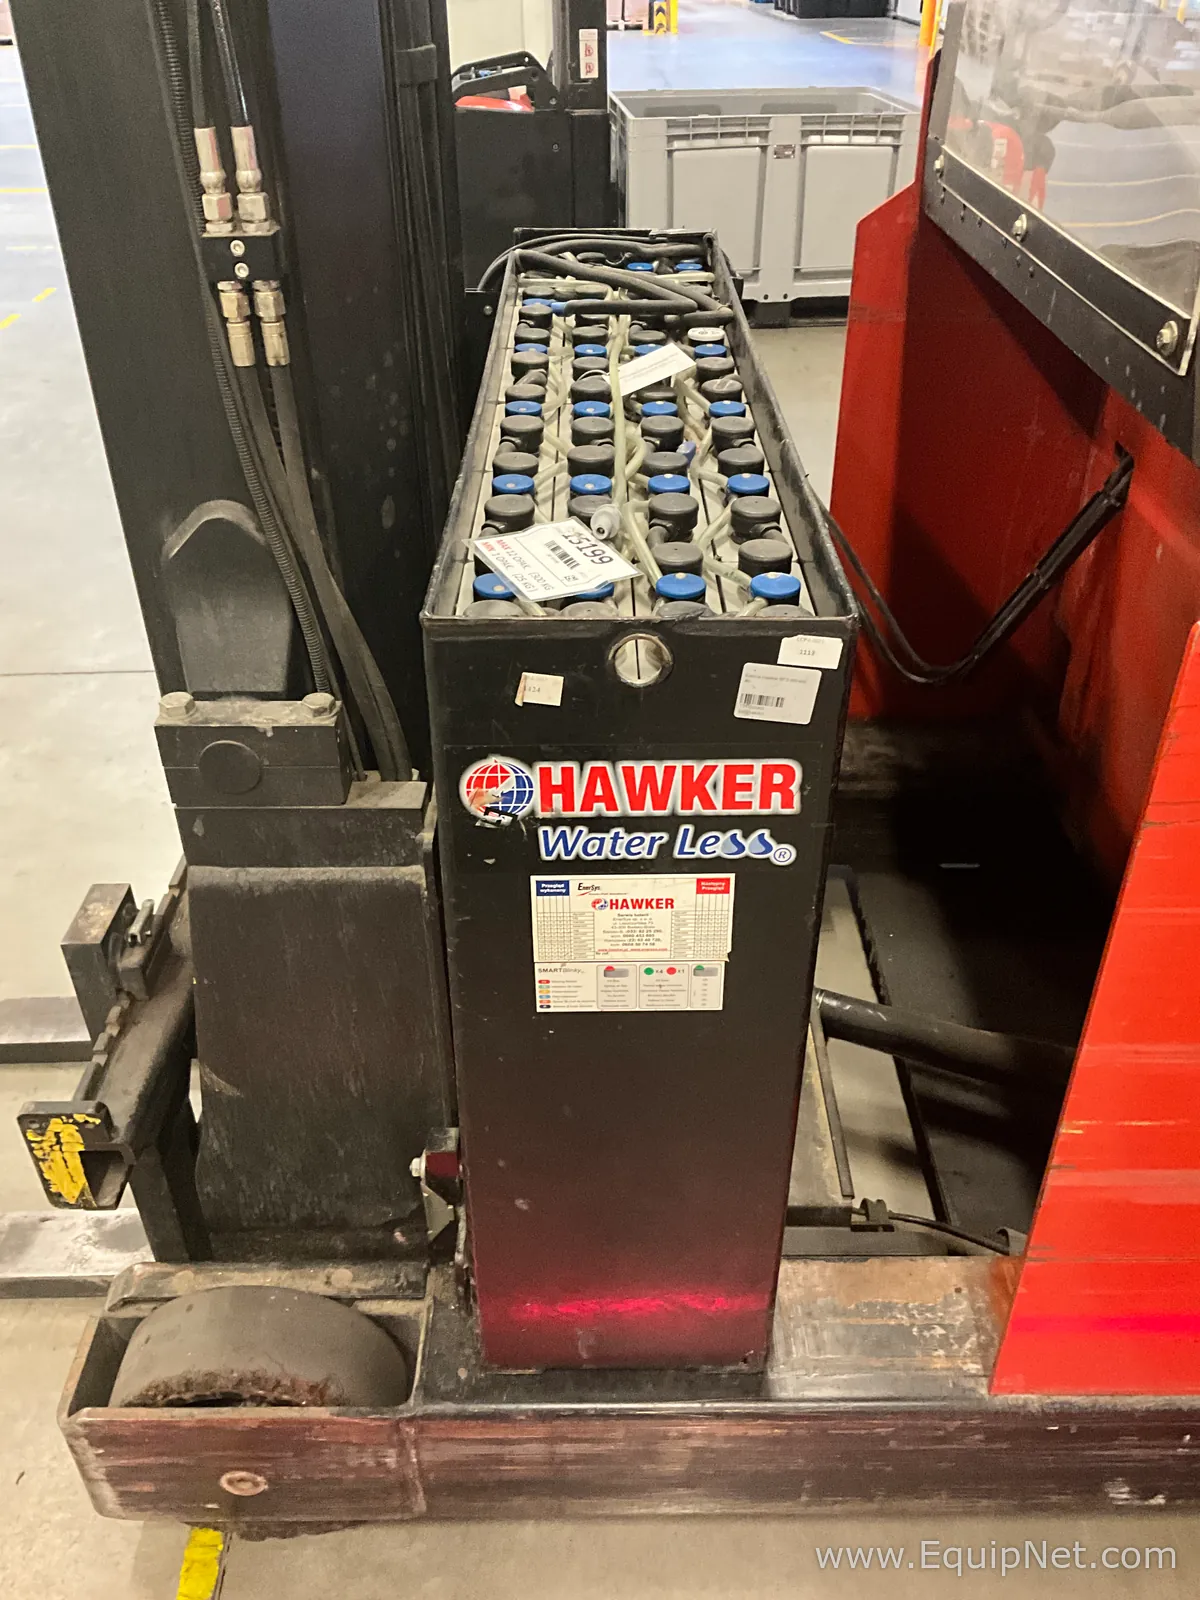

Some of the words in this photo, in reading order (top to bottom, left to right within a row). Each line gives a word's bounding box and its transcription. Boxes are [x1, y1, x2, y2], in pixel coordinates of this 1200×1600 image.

[538, 763, 798, 813] HAWKER
[541, 828, 666, 857] Water
[609, 898, 674, 910] HAWKER
